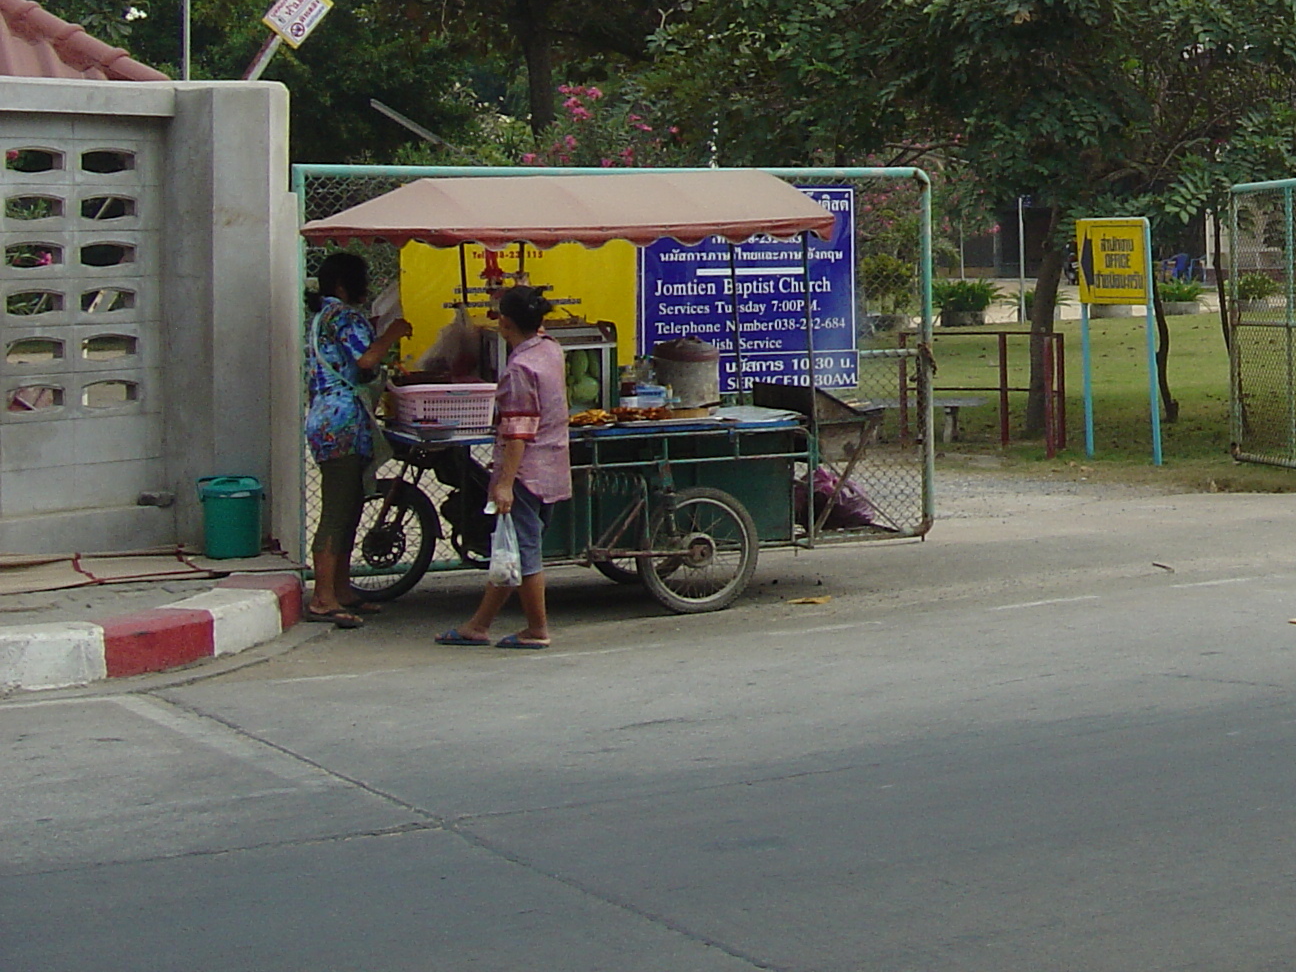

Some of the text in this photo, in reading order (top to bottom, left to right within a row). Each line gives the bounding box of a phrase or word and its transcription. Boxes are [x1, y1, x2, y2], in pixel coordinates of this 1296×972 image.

[1104, 254, 1131, 268] OFFICE
[654, 276, 831, 298] Jomtien Baptist Church
[658, 303, 710, 316] Services
[715, 300, 767, 315] Tusday
[655, 322, 721, 337] Telephone
[739, 337, 782, 349] Service
[791, 358, 834, 370] 1030
